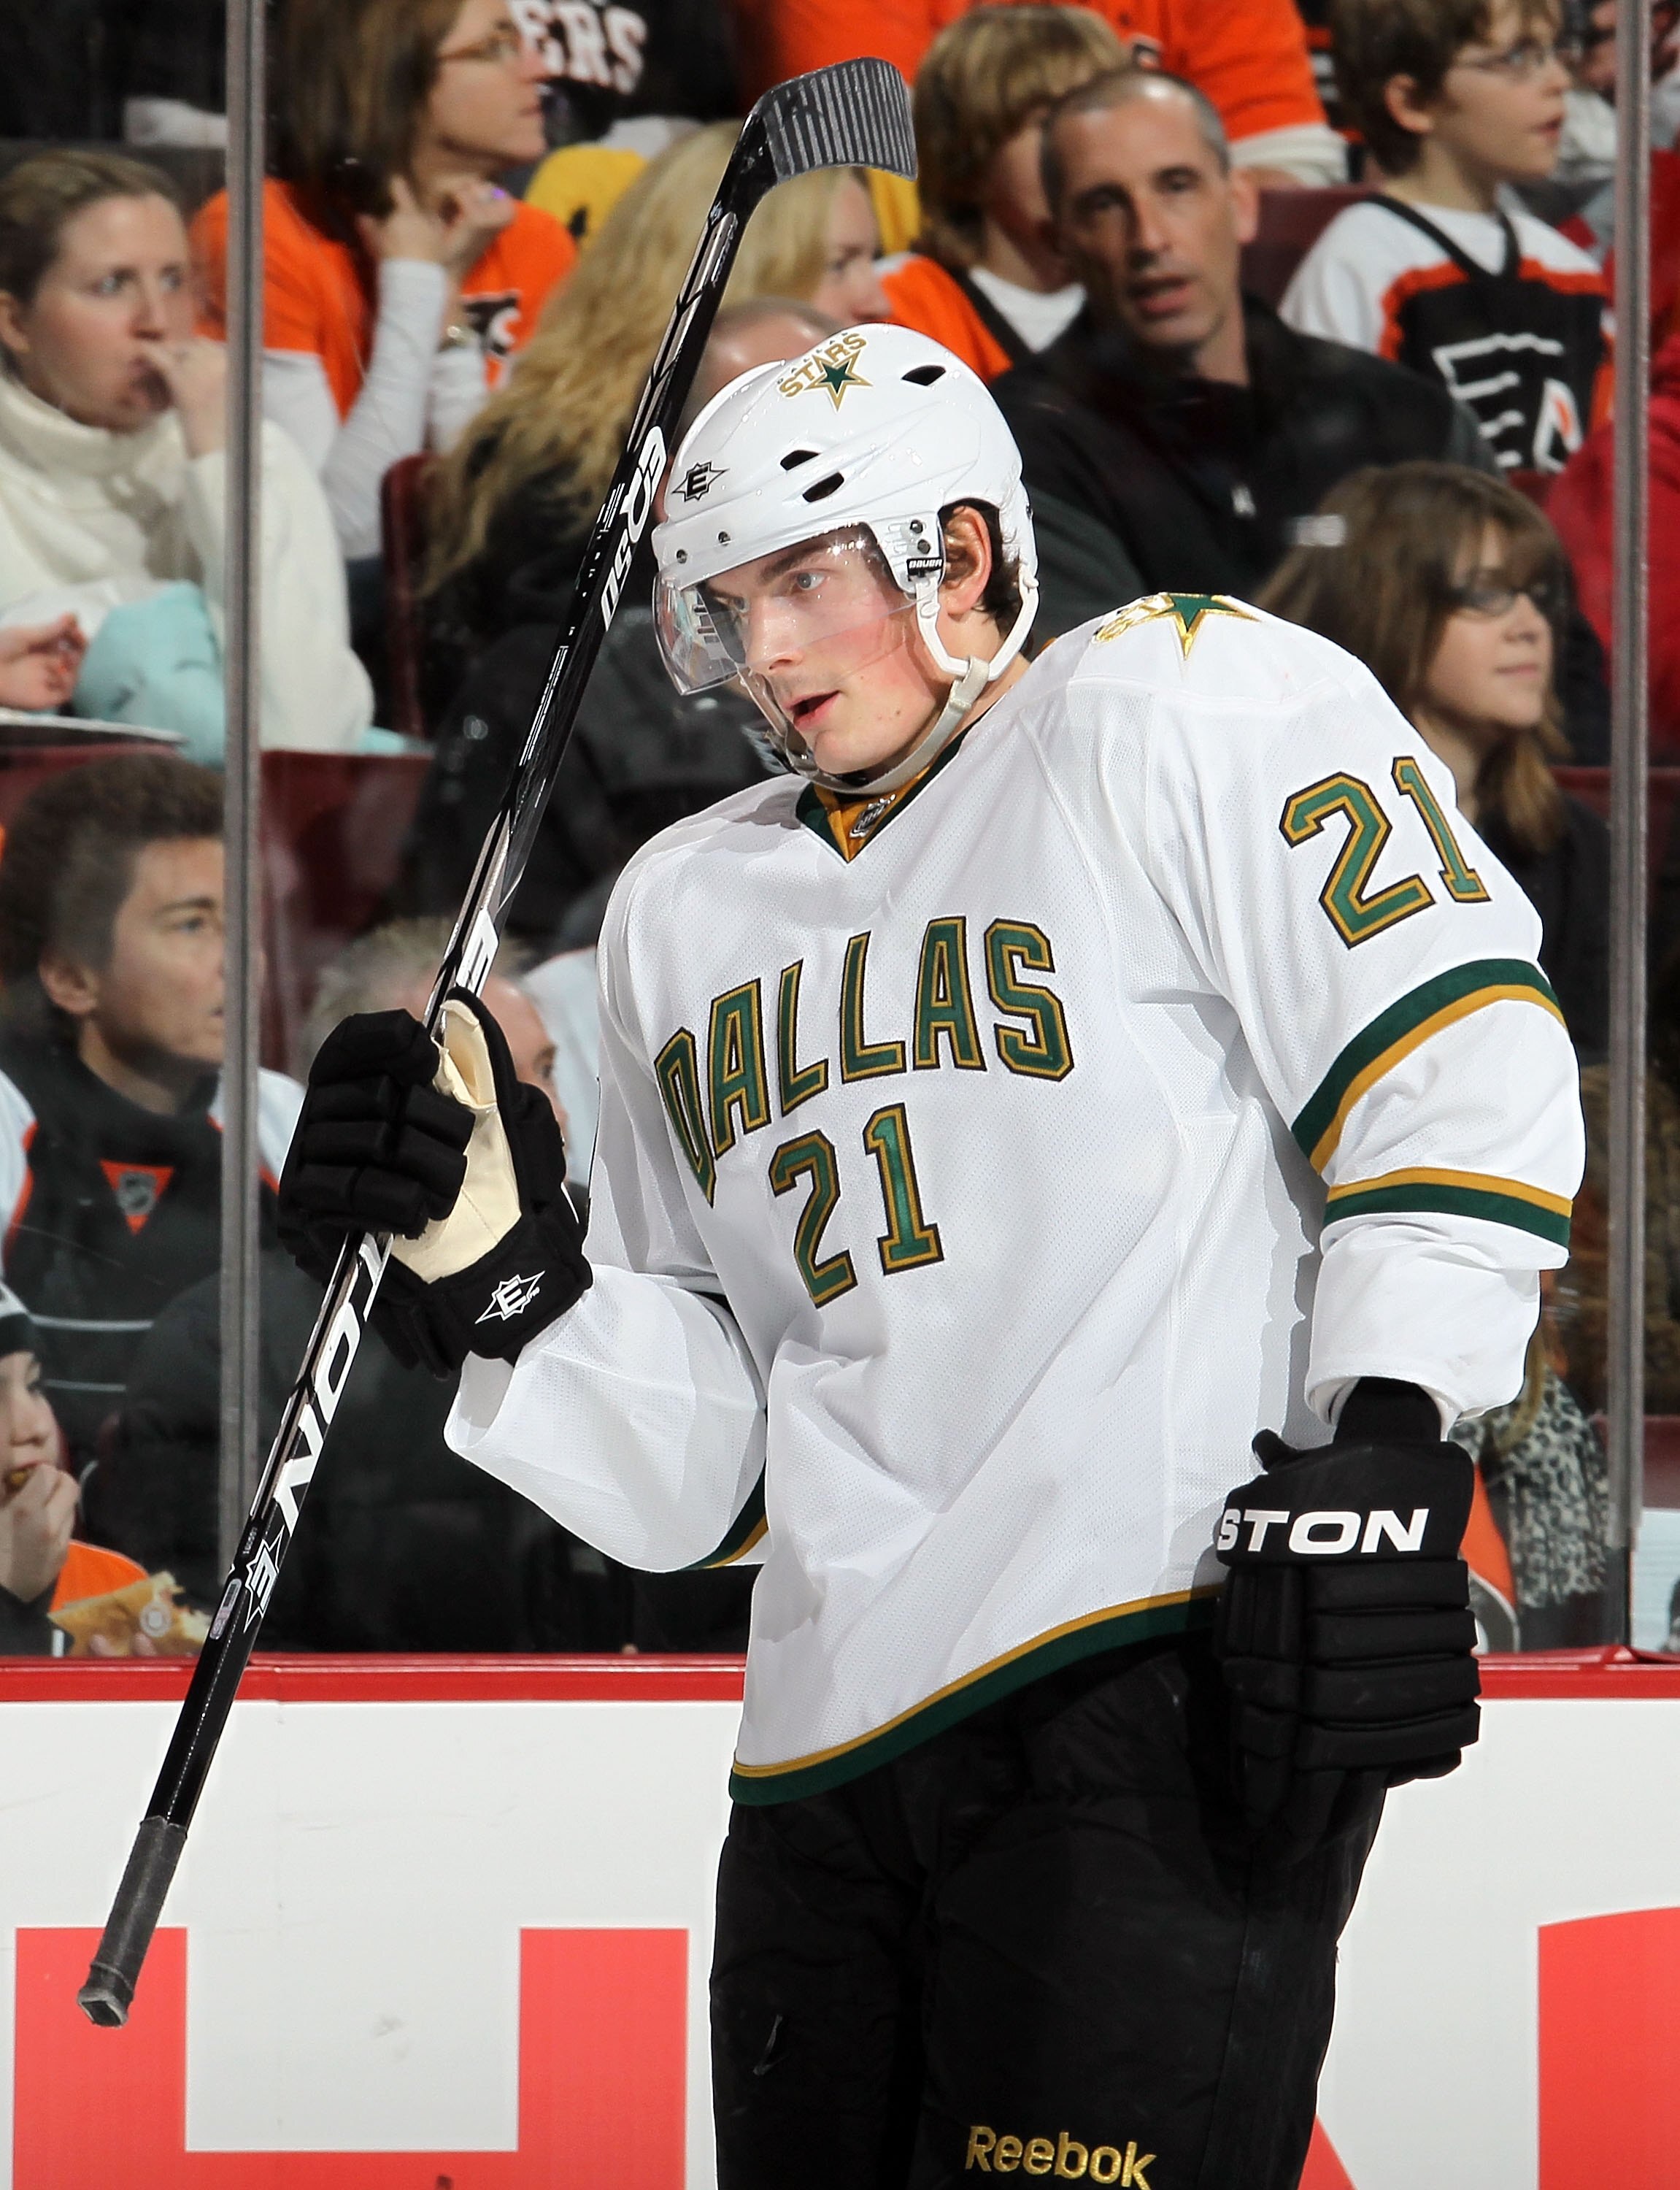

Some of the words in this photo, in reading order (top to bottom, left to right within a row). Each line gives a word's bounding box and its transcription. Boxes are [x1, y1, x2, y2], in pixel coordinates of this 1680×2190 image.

[1279, 756, 1491, 949] 21
[655, 916, 1074, 1207] DALLAS
[769, 1103, 944, 1308] 21
[965, 2126, 1157, 2190] Reebok
